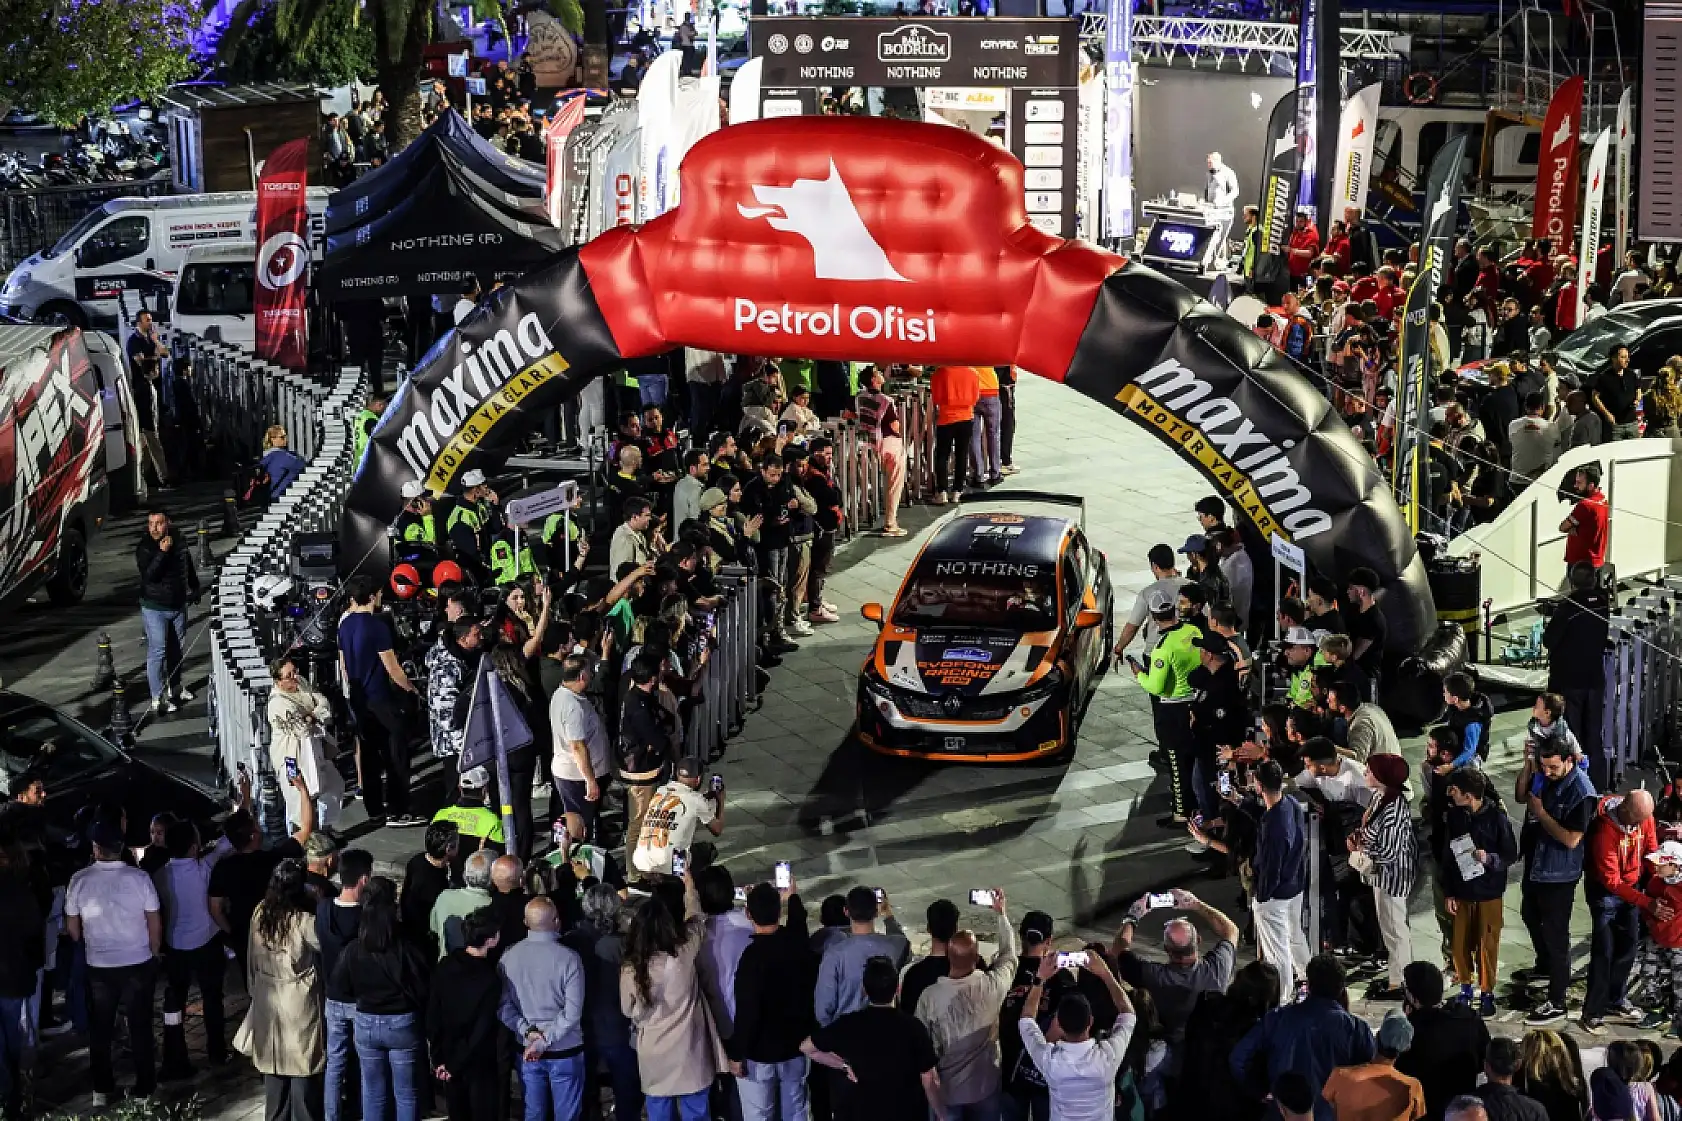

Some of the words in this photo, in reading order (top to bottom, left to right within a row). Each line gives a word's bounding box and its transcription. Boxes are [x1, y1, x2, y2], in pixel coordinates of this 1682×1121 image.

[884, 44, 946, 55] BODRUM
[800, 67, 855, 78] NOTHING
[887, 67, 941, 79] NOTHING
[973, 67, 1028, 79] NOTHING
[1548, 157, 1568, 213] Petrol
[1270, 176, 1291, 256] maxima
[390, 234, 474, 251] NOTHING
[479, 233, 503, 245] (R)
[341, 276, 384, 288] NOTHING
[418, 271, 460, 282] NOTHING
[735, 298, 840, 335] Petrol
[850, 306, 936, 342] Ofisi
[397, 312, 554, 480] maxima
[435, 424, 484, 483] MOTOR
[479, 362, 554, 422] YAĞLARI
[1136, 399, 1207, 456] MOTOR
[1133, 357, 1333, 542] maxima
[936, 561, 1040, 578] NOTHING
